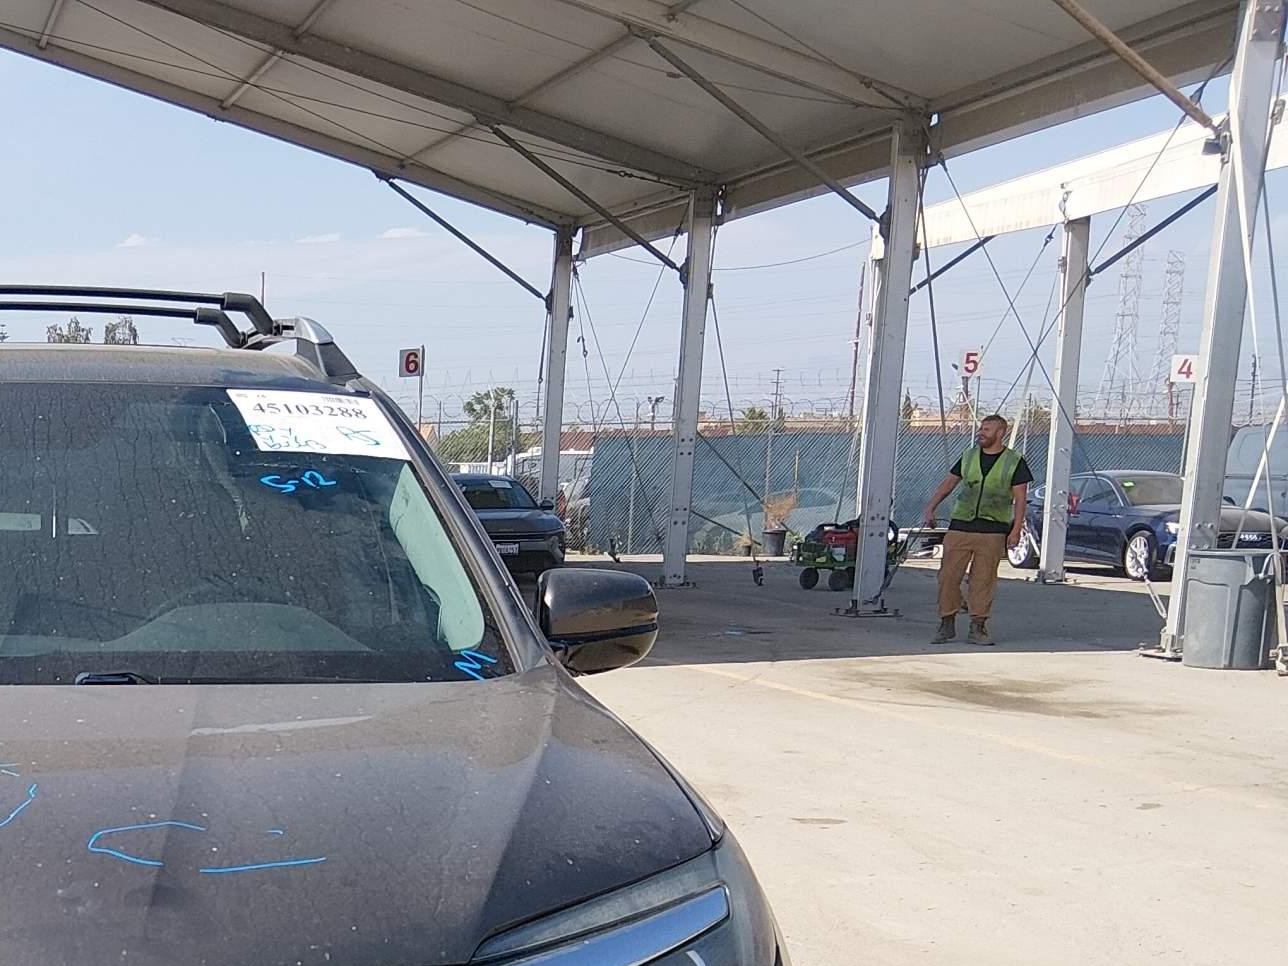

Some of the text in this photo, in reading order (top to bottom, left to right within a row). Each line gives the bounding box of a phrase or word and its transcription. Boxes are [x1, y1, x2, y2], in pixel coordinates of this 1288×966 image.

[405, 352, 418, 374] 6
[964, 352, 978, 374] 5
[1178, 358, 1193, 379] 4
[253, 402, 368, 419] 45103288
